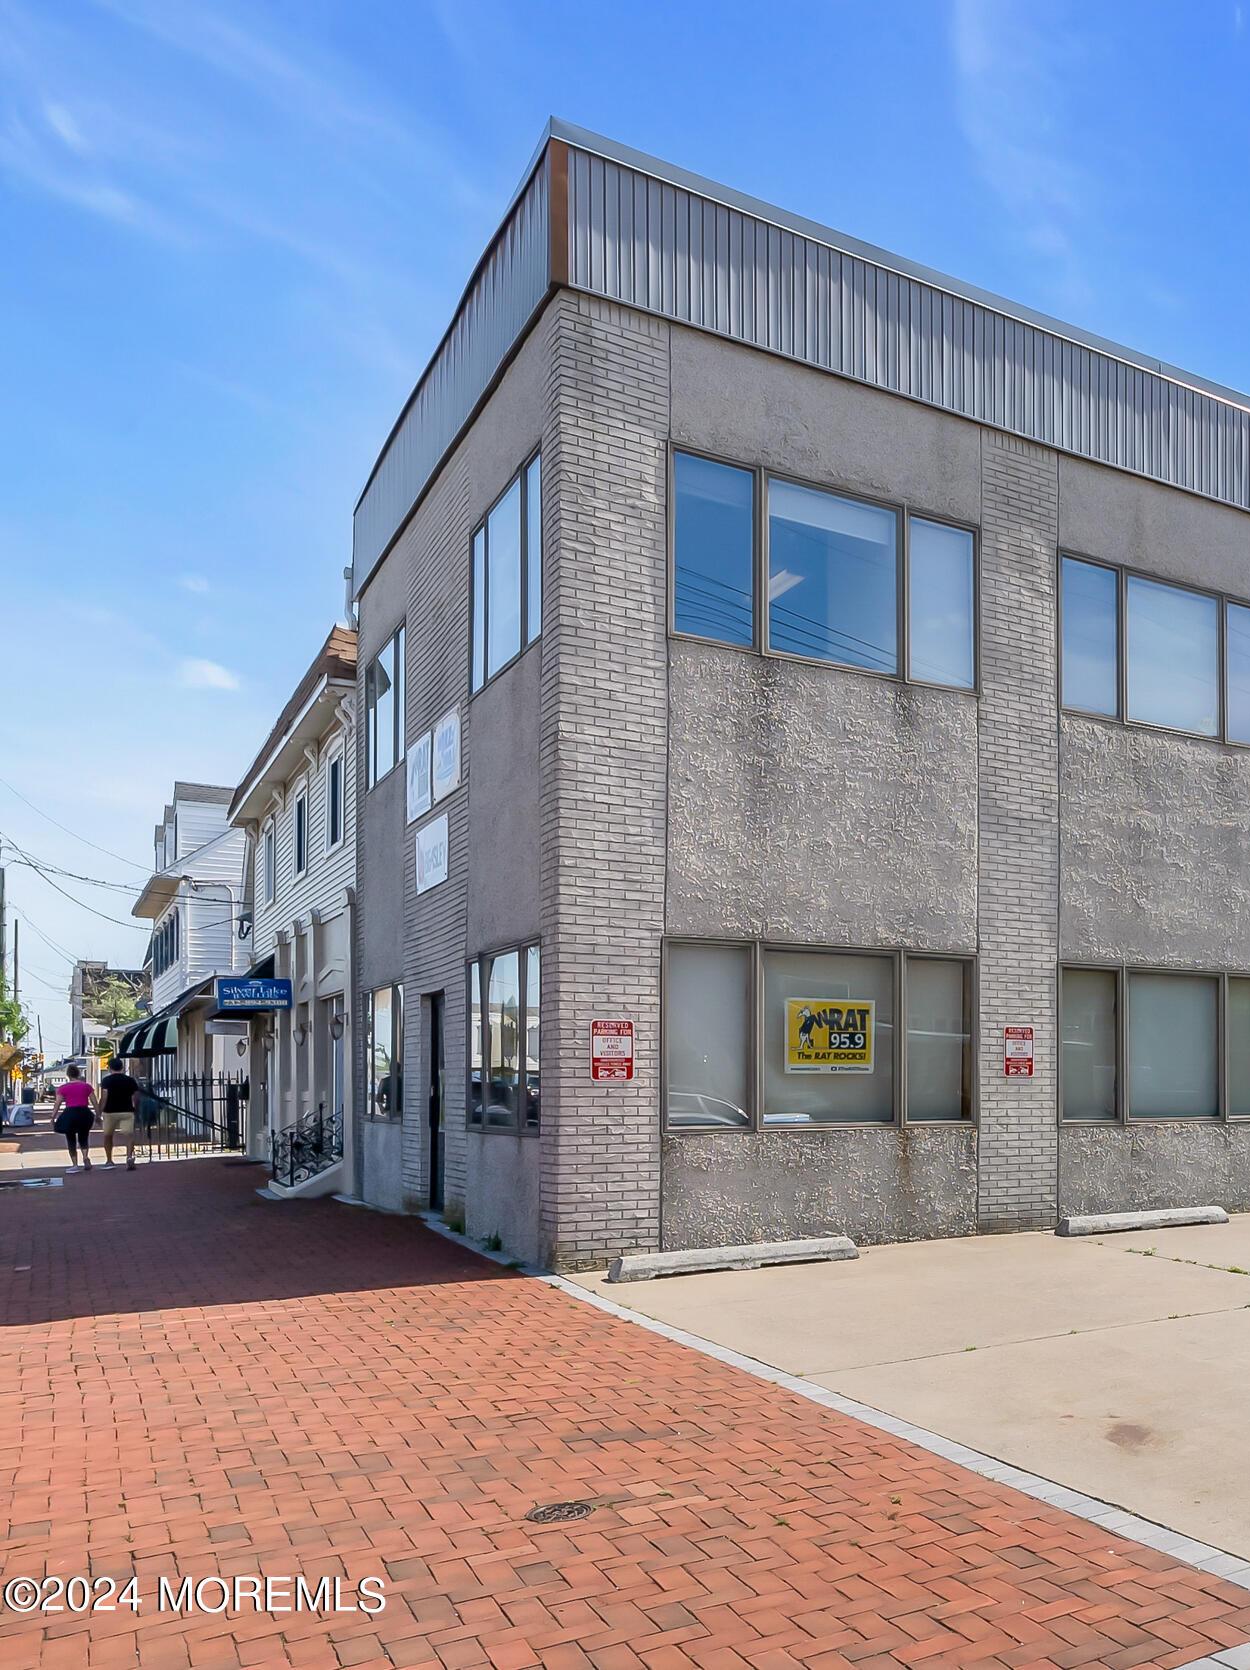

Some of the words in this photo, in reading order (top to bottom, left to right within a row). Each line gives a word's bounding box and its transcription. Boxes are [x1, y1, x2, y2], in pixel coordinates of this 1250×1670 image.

[223, 986, 256, 995] Silver
[259, 986, 288, 995] Lake
[830, 1033, 864, 1049] 95.9
[797, 1052, 812, 1060] The
[814, 1052, 832, 1060] RAT
[833, 1052, 866, 1060] ROCKS!
